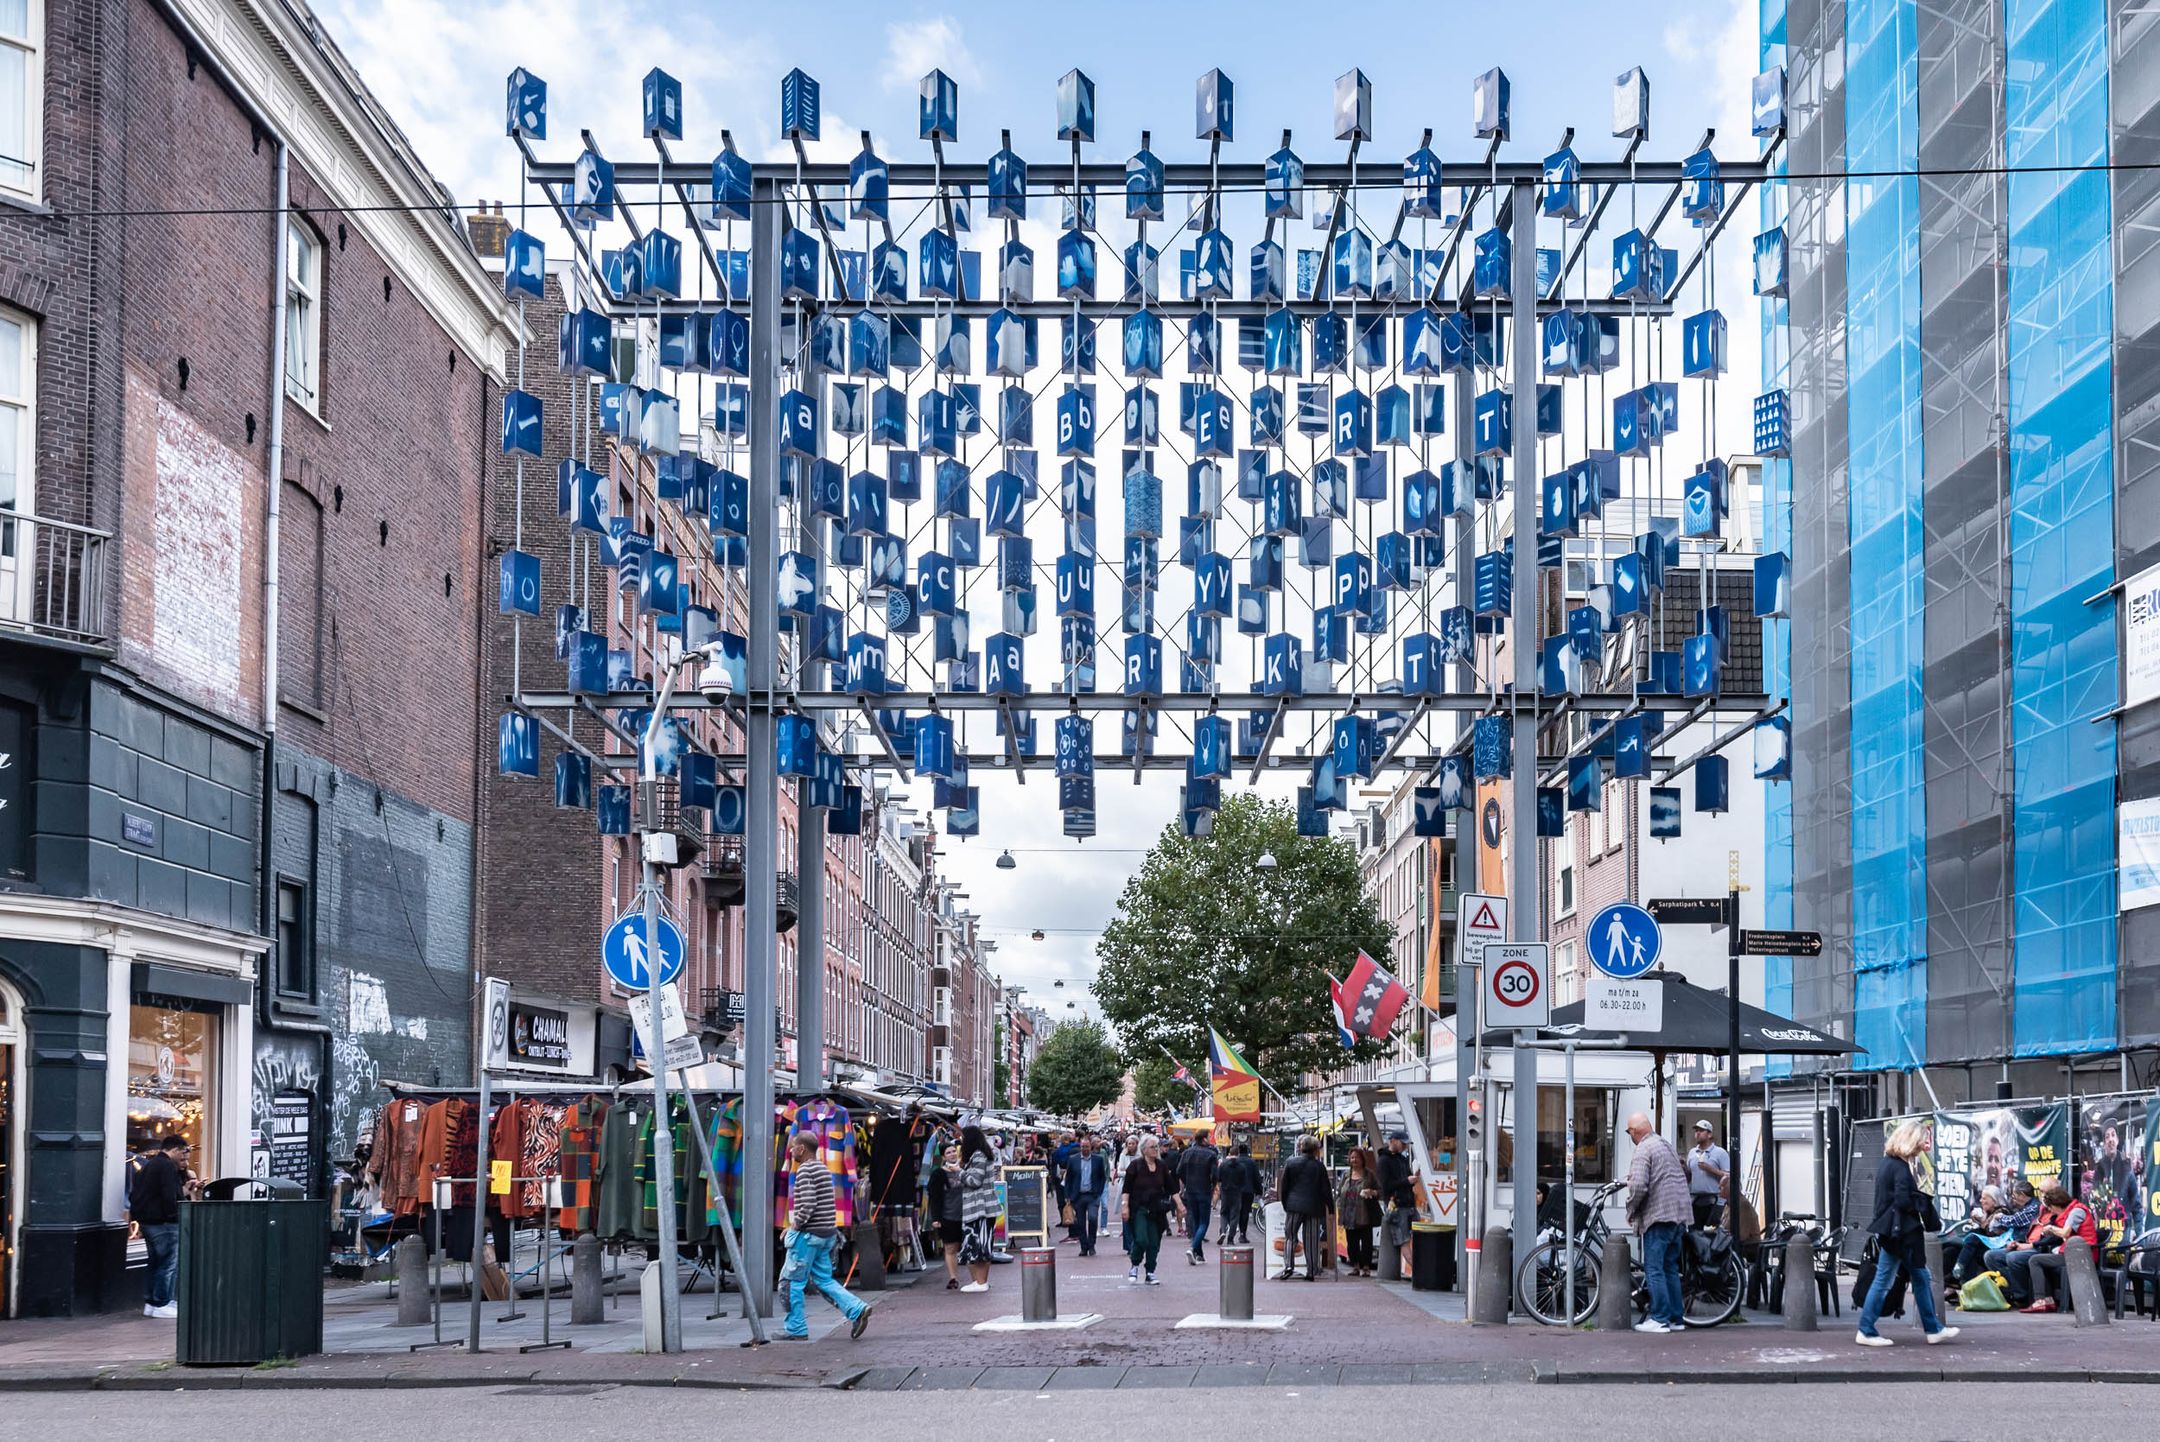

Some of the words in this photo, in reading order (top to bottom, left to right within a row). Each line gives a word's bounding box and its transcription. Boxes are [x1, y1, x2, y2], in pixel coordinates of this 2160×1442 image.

[1502, 949, 1529, 957] ZONE
[1502, 975, 1531, 993] 30
[1608, 989, 1617, 997] ma
[1619, 988, 1631, 997] t/m
[1632, 990, 1639, 998] za
[1936, 1124, 1971, 1148] GOED
[2040, 1145, 2055, 1160] DE
